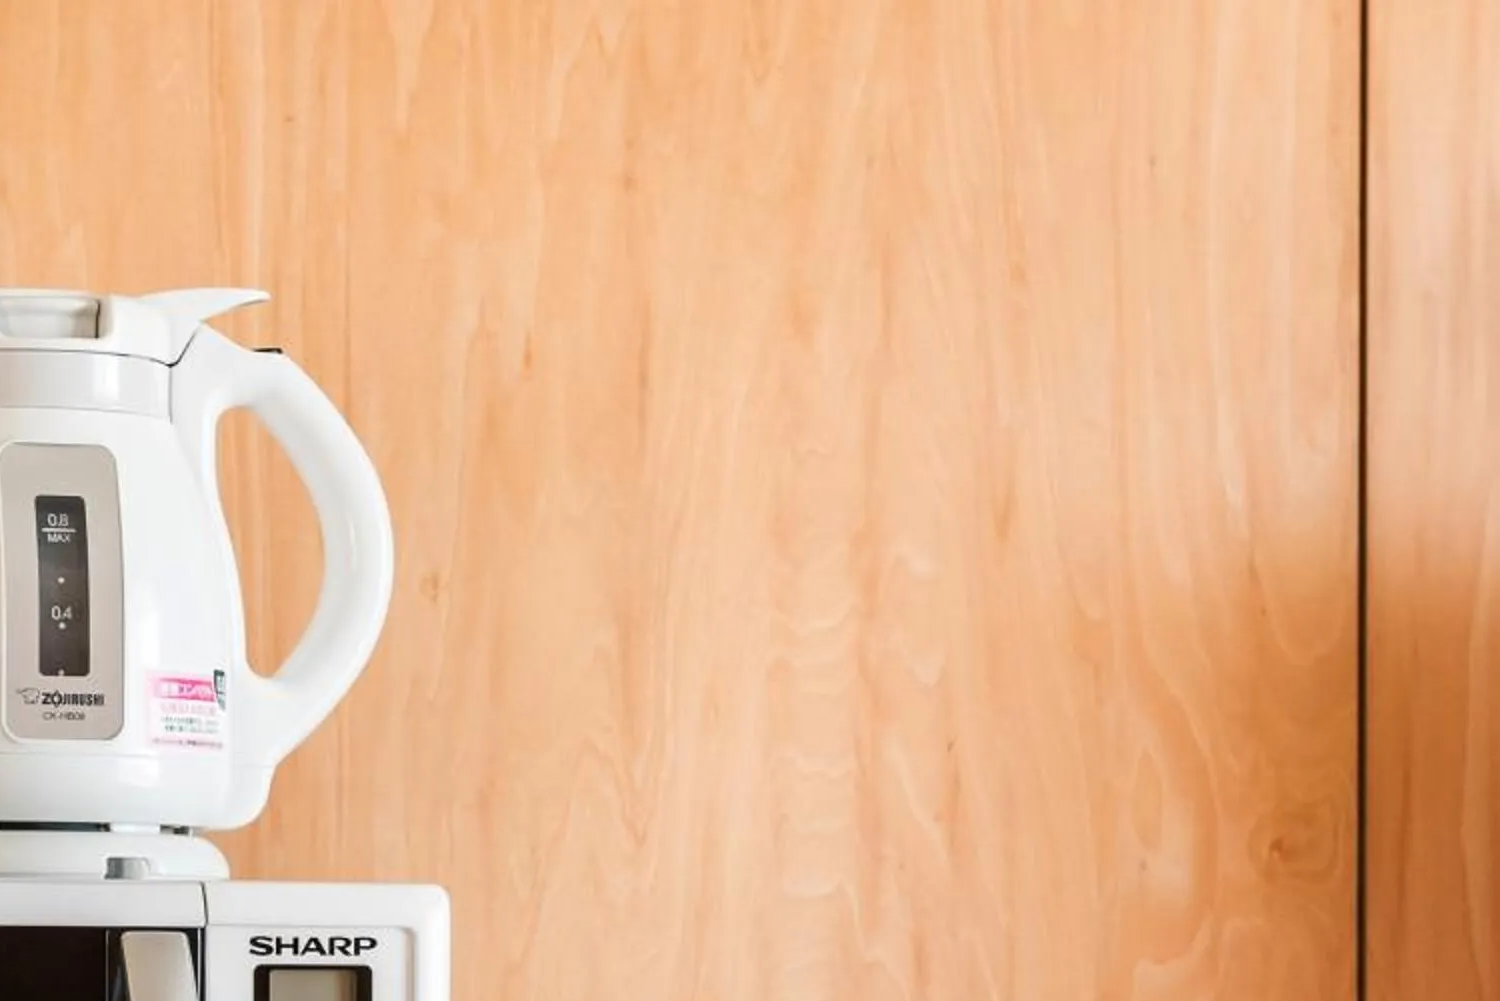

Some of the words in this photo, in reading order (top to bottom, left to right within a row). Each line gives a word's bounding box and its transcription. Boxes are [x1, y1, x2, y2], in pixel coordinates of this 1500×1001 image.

[47, 513, 69, 527] 0.8
[47, 532, 71, 543] MAX
[51, 605, 72, 620] 0.4
[41, 690, 105, 708] ZOJIRUSHI
[249, 936, 377, 956] SHARP
